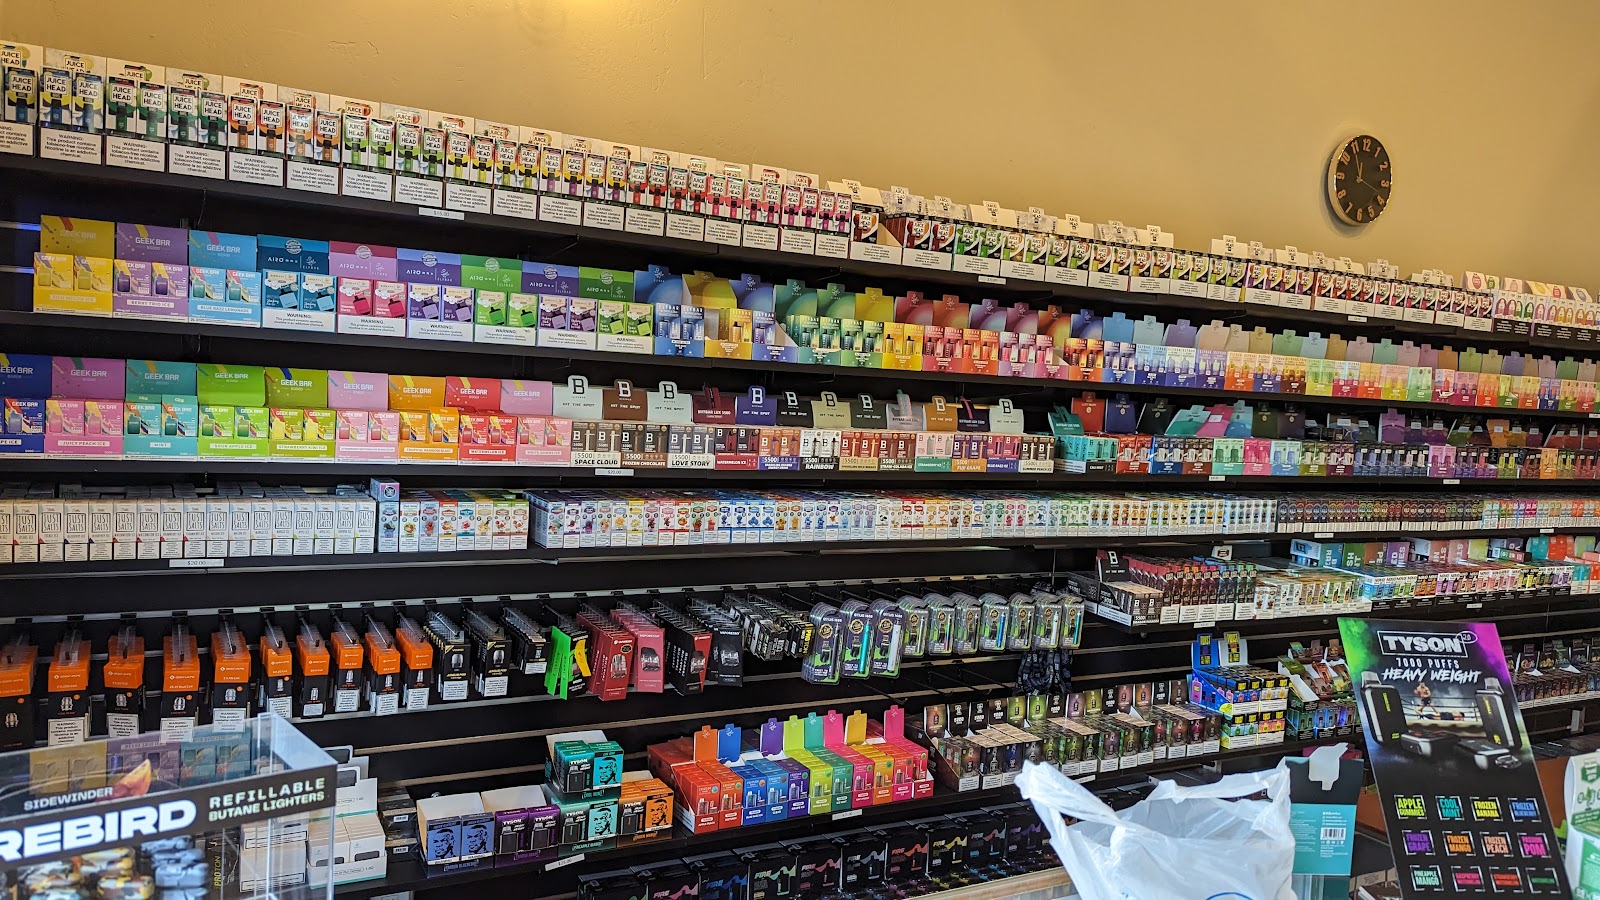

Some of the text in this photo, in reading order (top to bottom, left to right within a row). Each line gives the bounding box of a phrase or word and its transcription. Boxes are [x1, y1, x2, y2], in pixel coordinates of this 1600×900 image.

[12, 76, 31, 84] JUICE
[46, 77, 66, 85] JUICE
[46, 84, 67, 92] HEAD
[80, 82, 98, 90] JUICE
[79, 89, 98, 97] HEAD
[234, 112, 252, 120] HEAD
[1351, 140, 1359, 154] 11
[1363, 138, 1371, 152] 12
[1375, 147, 1381, 158] 1
[1341, 151, 1351, 165] 10
[1379, 161, 1388, 171] 2
[1336, 172, 1345, 180] 9
[1381, 180, 1389, 188] 3
[1337, 189, 1346, 199] 8
[1376, 194, 1385, 205] 4
[1345, 202, 1353, 214] 7
[1367, 205, 1375, 218] 5
[1357, 208, 1362, 221] 6
[135, 237, 171, 246] GEEK BAR
[206, 244, 225, 252] GEEK
[572, 378, 585, 394] B
[617, 381, 631, 397] B
[663, 383, 675, 399] B
[752, 388, 763, 404] B
[785, 392, 799, 406] B
[824, 393, 836, 407] B
[860, 395, 872, 409] B
[934, 397, 945, 411] B
[1001, 401, 1011, 413] B
[573, 430, 581, 440] B
[18, 515, 34, 525] JUST
[44, 513, 59, 523] JUST
[69, 514, 84, 523] JUST
[18, 525, 33, 533] SALTS
[44, 523, 59, 531] SALTS
[69, 523, 84, 532] SALTS
[1108, 551, 1118, 564] B
[1383, 636, 1462, 652] TYSON
[1396, 658, 1459, 668] 7000 PUFFS
[1382, 667, 1482, 683] HEAVY WEIGHT
[209, 778, 325, 809] REFILLABLE
[24, 787, 113, 811] SIDEWINDER
[1398, 798, 1423, 808] APPLE
[1440, 799, 1459, 808] COOL
[208, 791, 325, 822] BUTANE LIGHTERS
[1474, 801, 1497, 809] FROZEN
[1512, 802, 1535, 810] FROZEN
[1442, 808, 1460, 817] MINT
[1447, 835, 1469, 843] FROZEN
[1484, 836, 1507, 844] FROZEN
[1408, 842, 1431, 851] GRAPE
[1449, 844, 1472, 852] MANGO
[1487, 844, 1509, 854] PEACH
[1524, 843, 1546, 855] POM
[1415, 876, 1440, 886] MANGO
